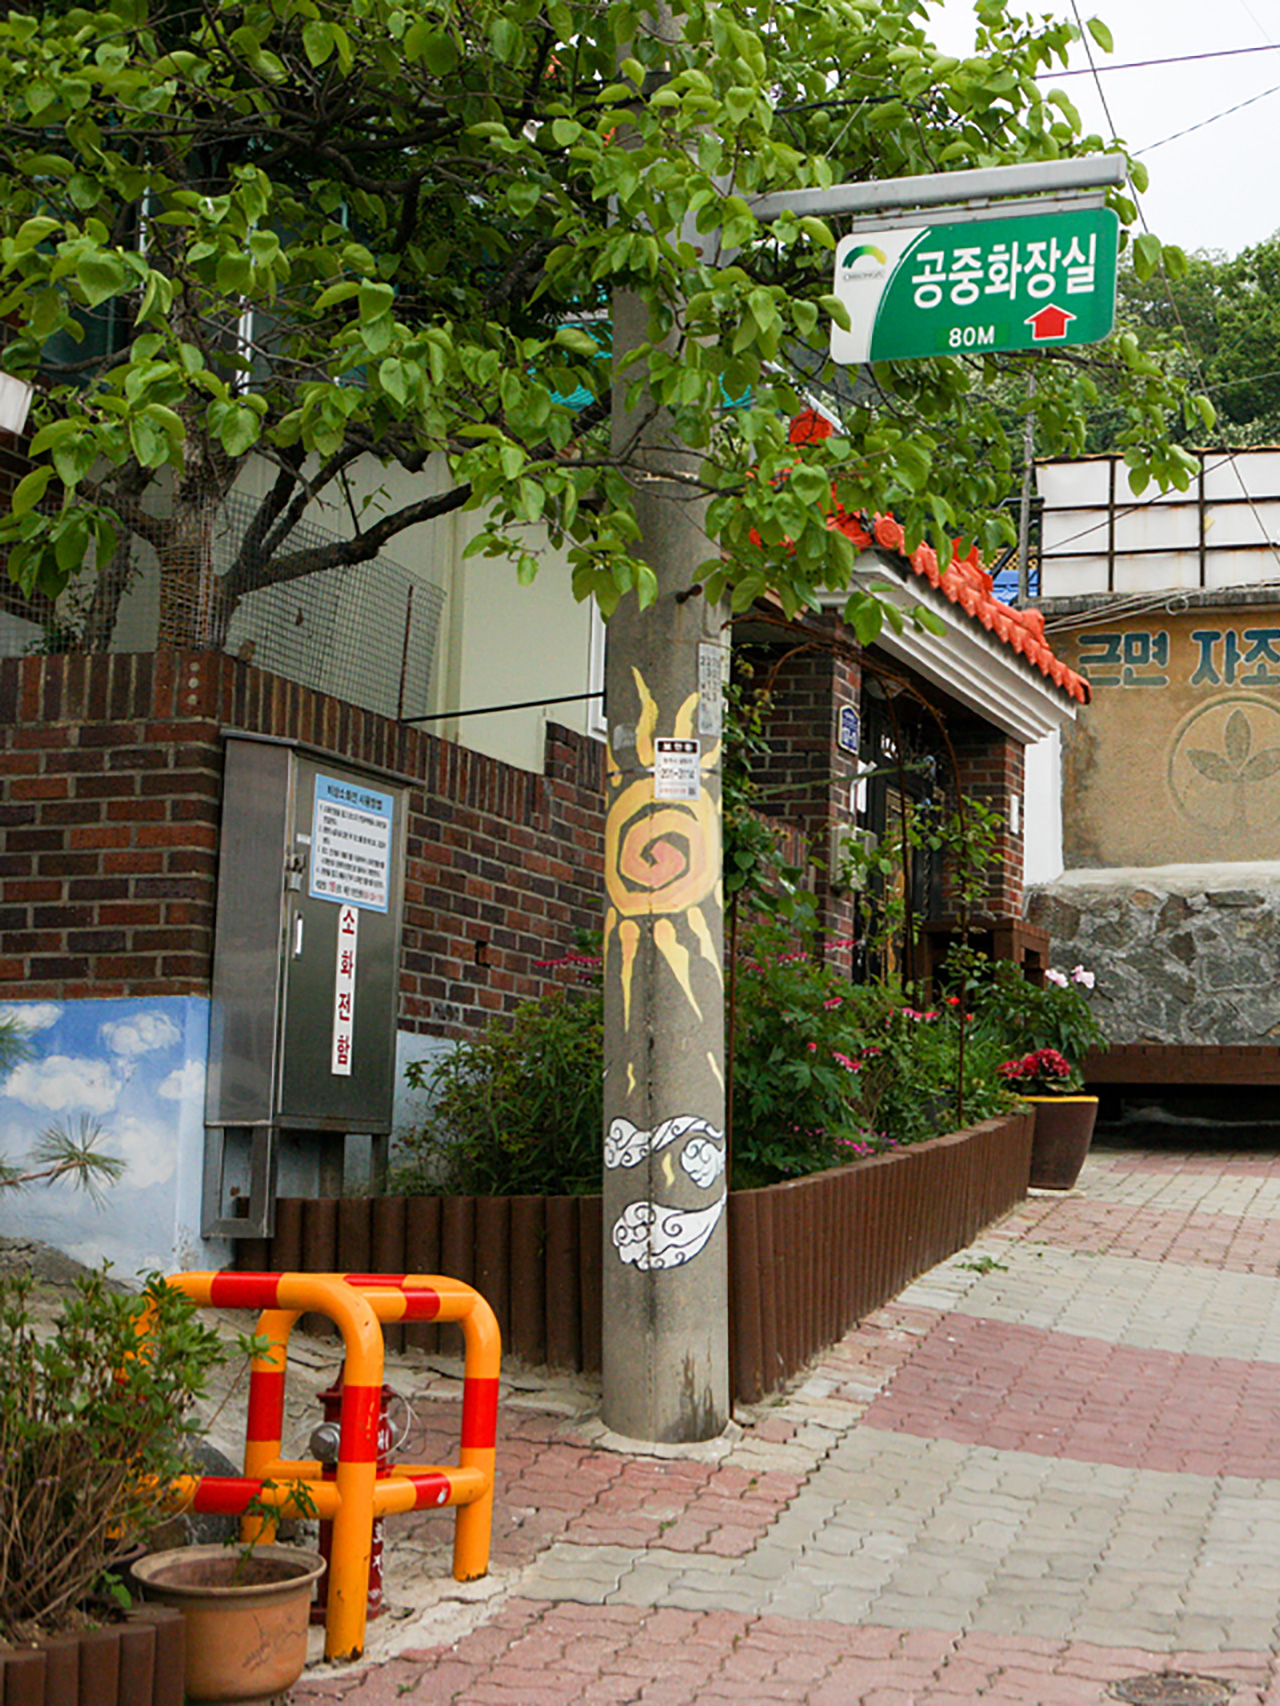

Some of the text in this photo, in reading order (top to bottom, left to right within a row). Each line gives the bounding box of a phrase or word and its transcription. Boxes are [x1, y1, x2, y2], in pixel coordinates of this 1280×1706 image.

[912, 233, 1097, 309] 공중화장실
[948, 325, 995, 348] 80M
[1078, 631, 1170, 687] 근면
[337, 908, 356, 1066] 소화전함
